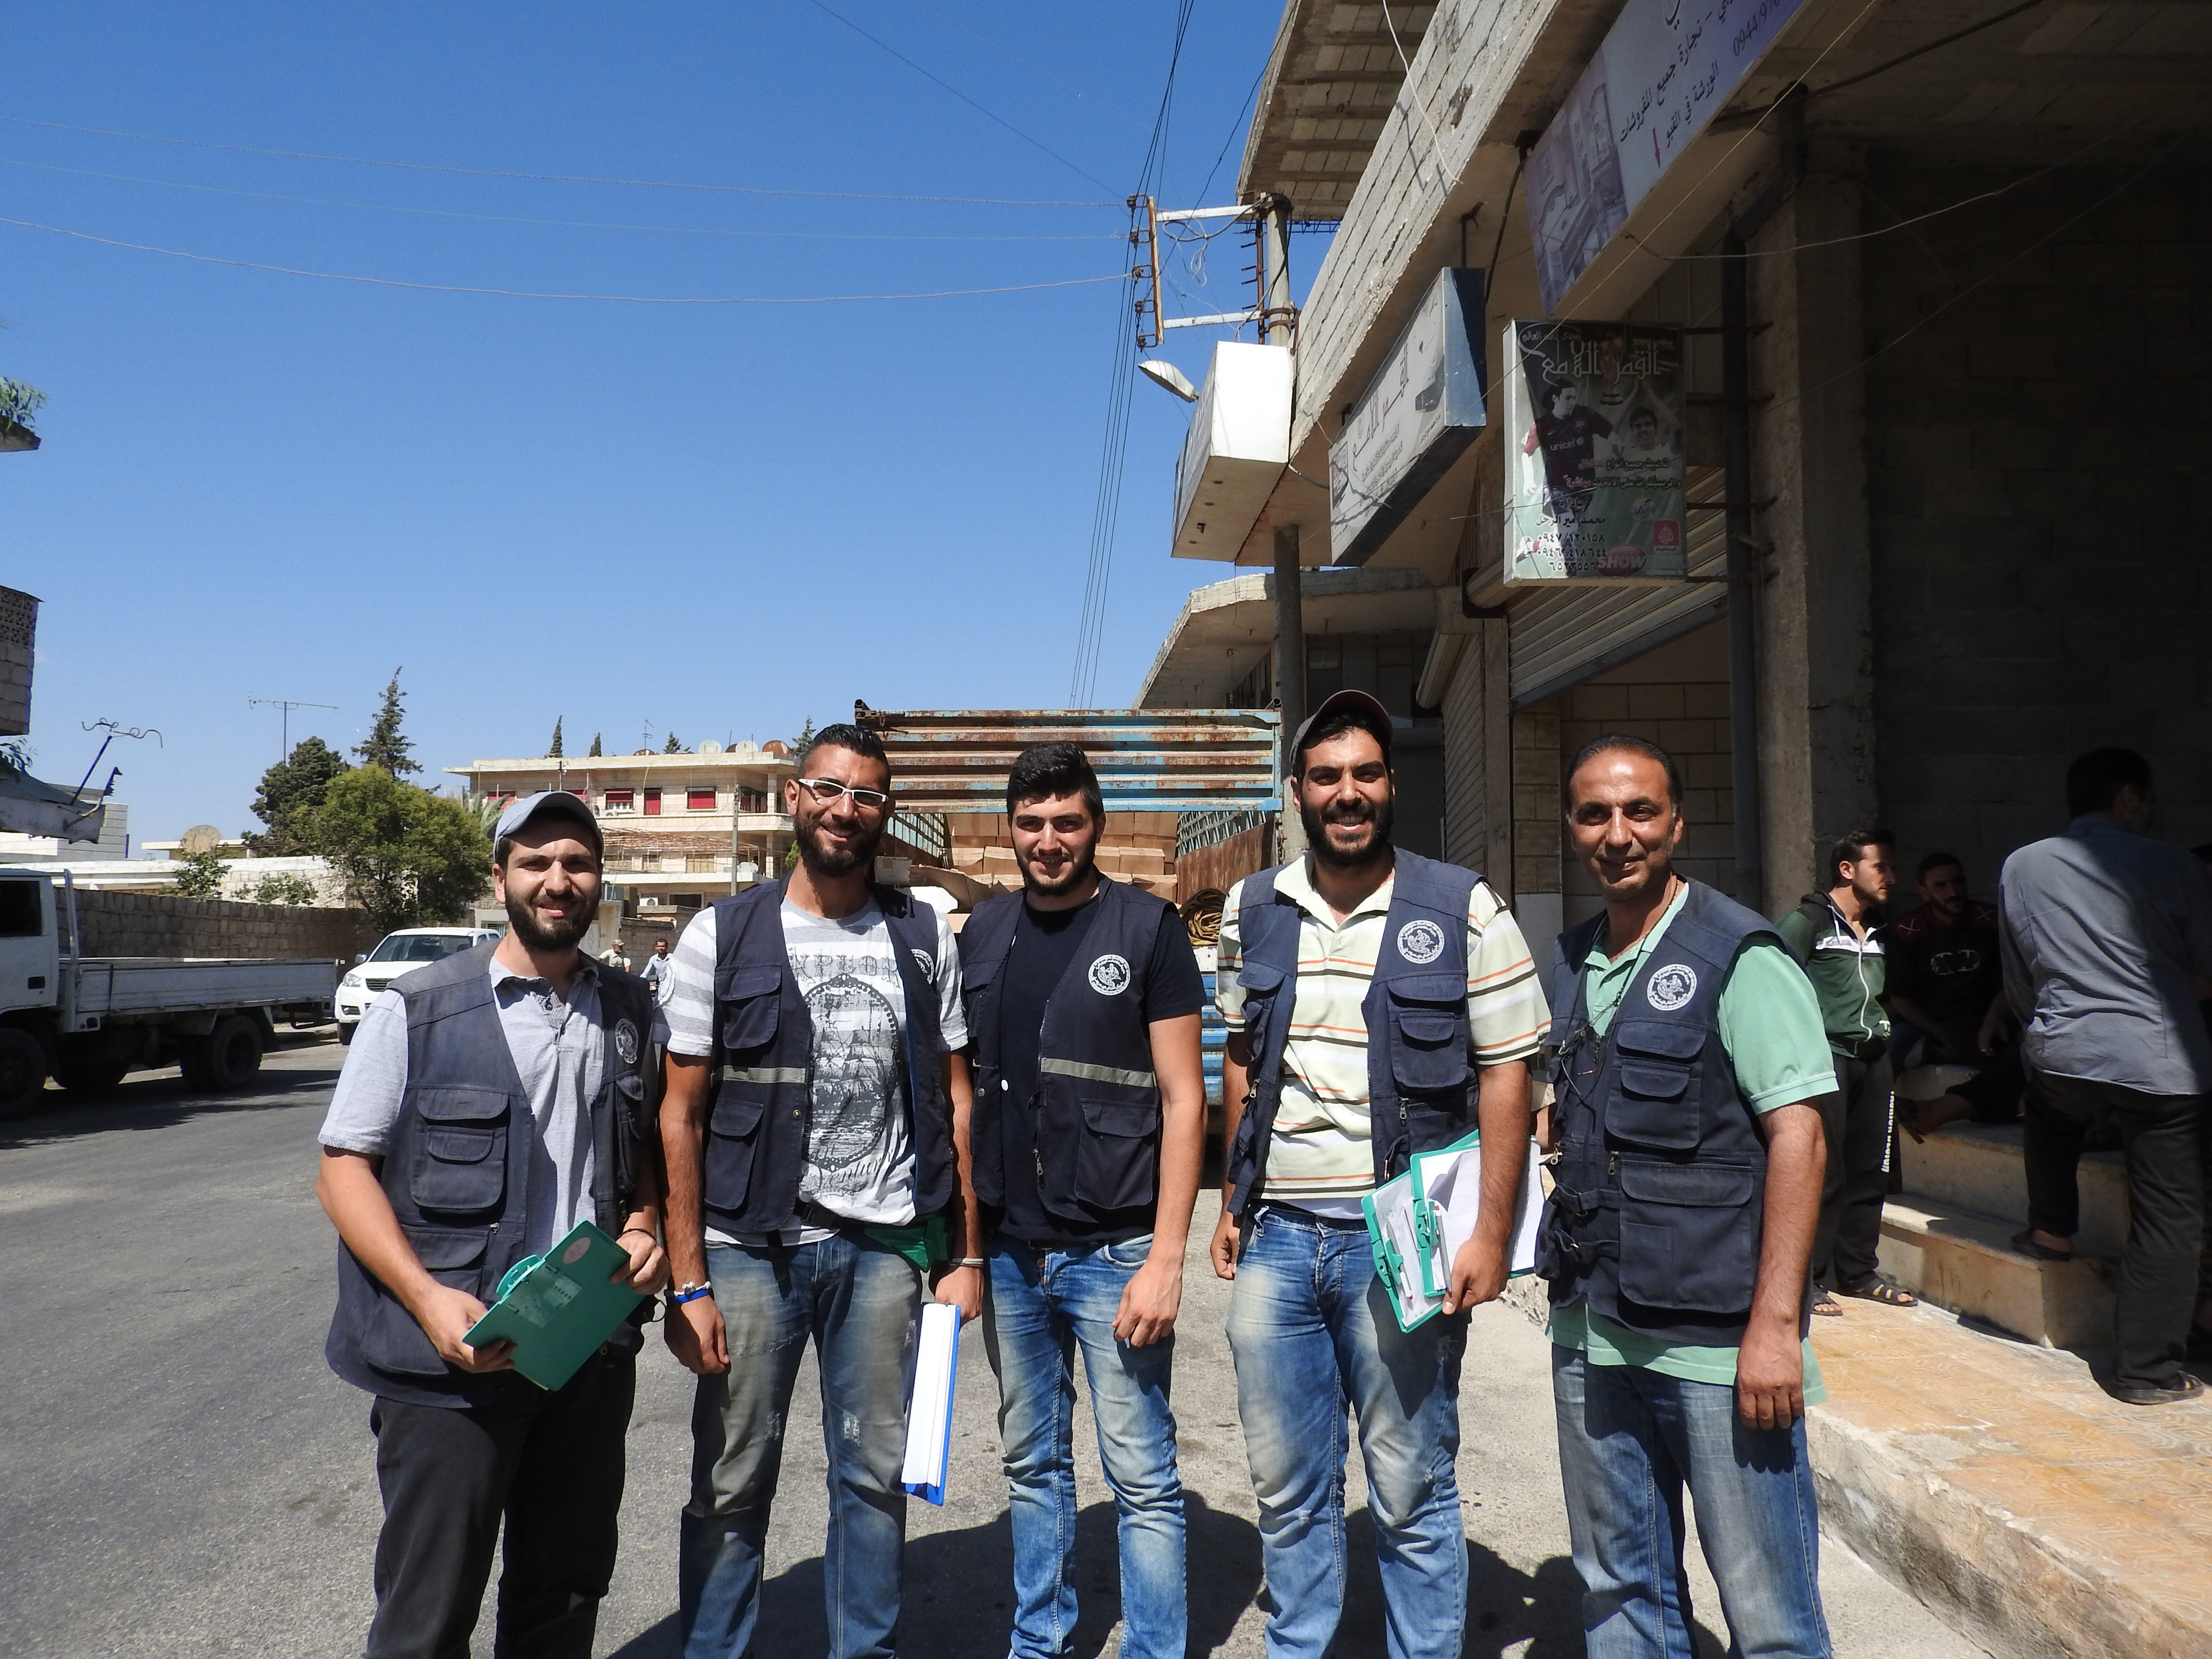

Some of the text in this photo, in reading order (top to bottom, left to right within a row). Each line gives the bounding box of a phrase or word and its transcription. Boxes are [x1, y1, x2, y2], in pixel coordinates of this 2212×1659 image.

[1677, 19, 1702, 66] نجارة
[1656, 63, 1676, 108] جميع
[1685, 95, 1692, 125] في
[1541, 339, 1663, 387] القمر اللامع
[1382, 340, 1410, 433] القمر
[1550, 438, 1575, 451] unicef
